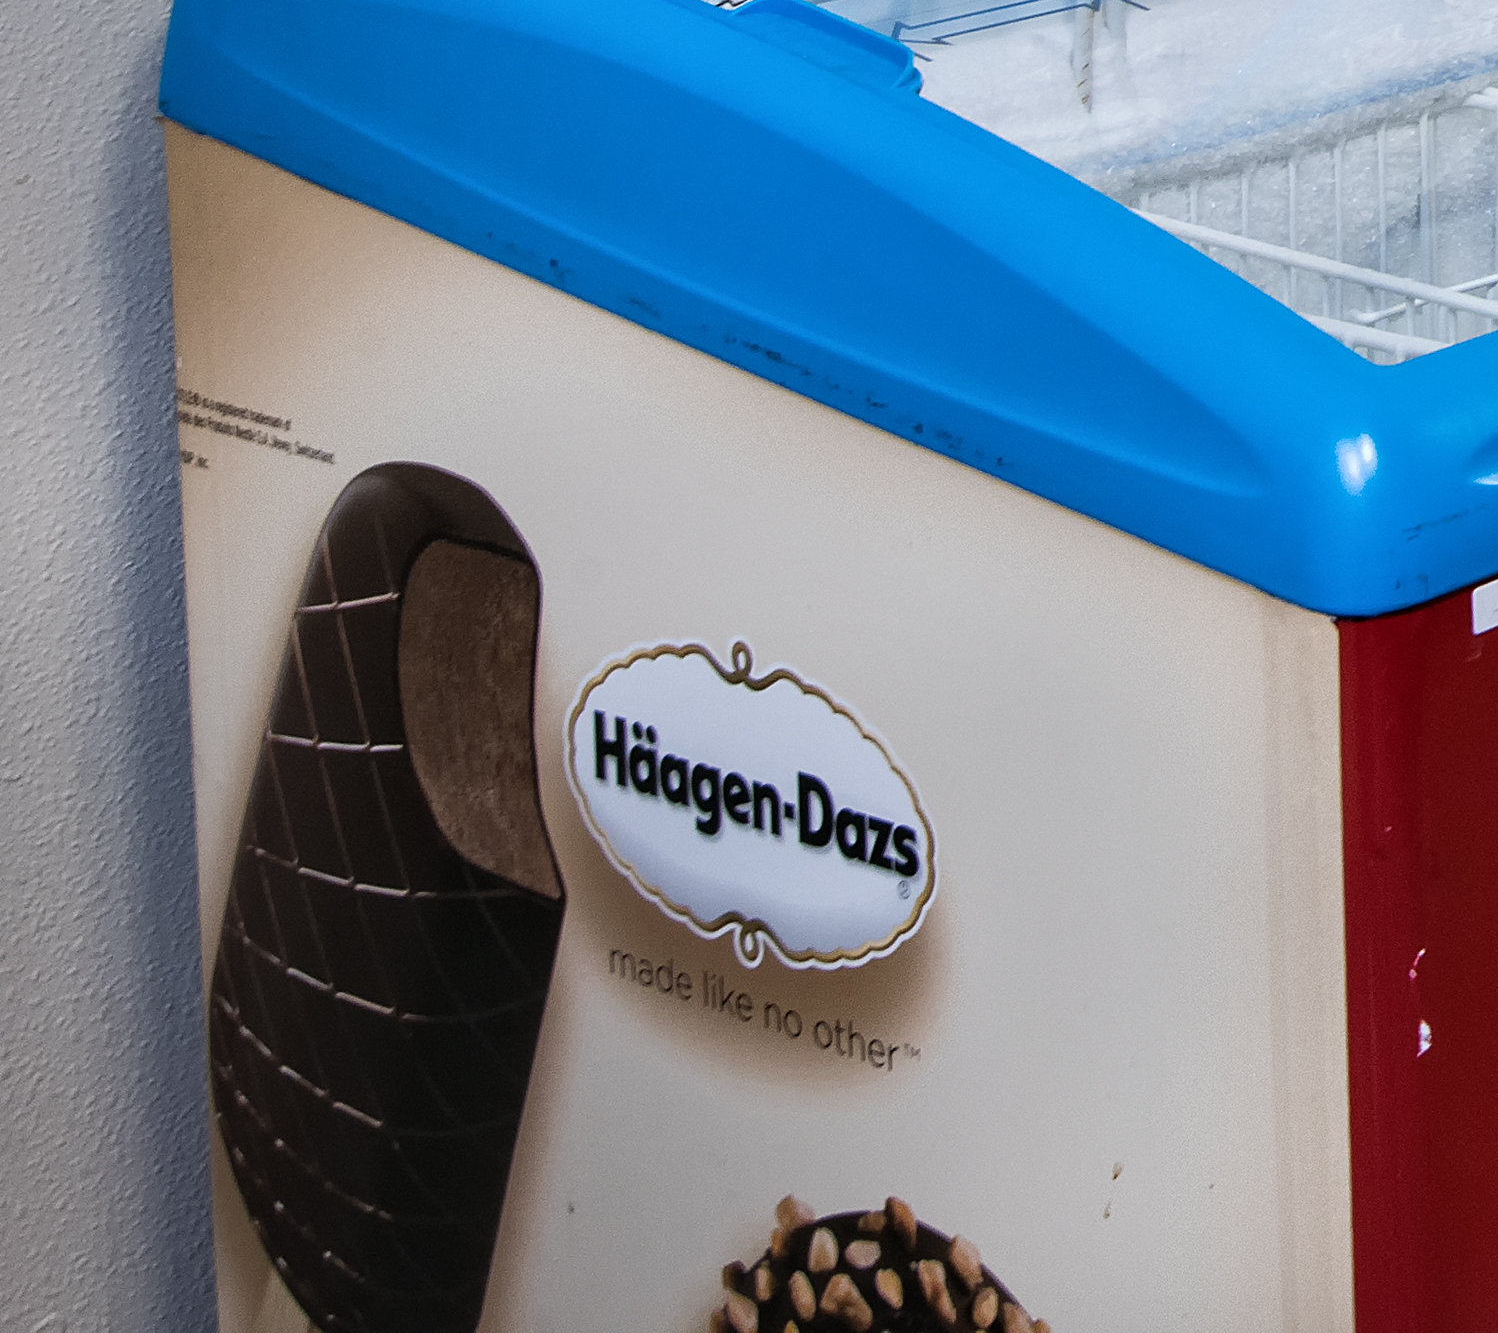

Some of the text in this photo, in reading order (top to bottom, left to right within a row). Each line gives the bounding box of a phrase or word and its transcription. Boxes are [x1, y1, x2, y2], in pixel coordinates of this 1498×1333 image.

[592, 710, 920, 879] Häagen-Dazs
[608, 941, 694, 1002] made
[702, 969, 755, 1025] like
[763, 1001, 804, 1041] no
